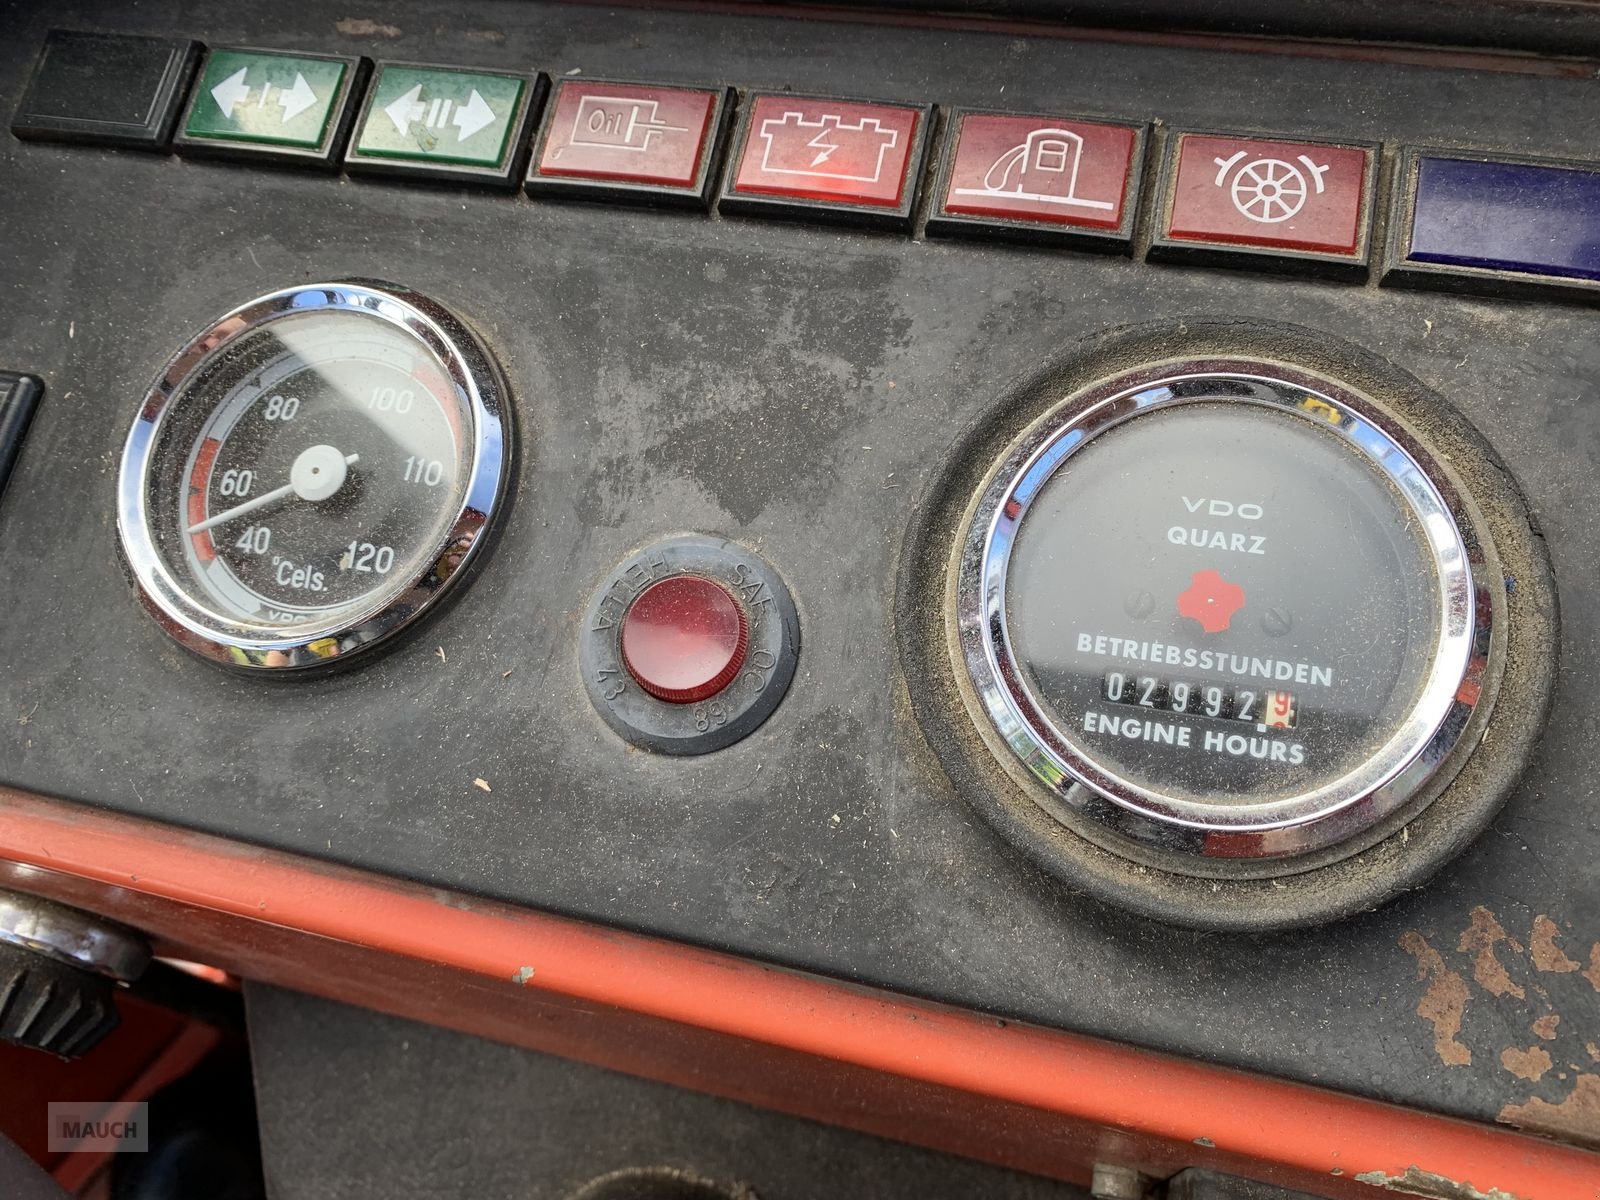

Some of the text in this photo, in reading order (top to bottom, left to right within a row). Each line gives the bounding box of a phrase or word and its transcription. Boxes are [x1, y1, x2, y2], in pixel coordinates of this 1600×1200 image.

[588, 109, 623, 135] Oil
[264, 396, 300, 421] 80
[367, 387, 414, 414] 100
[219, 470, 252, 496] 60
[403, 456, 444, 486] 110
[1182, 496, 1263, 520] VDO
[236, 527, 271, 555] 40
[1167, 526, 1266, 554] QUARZ
[347, 541, 394, 574] 120
[1076, 633, 1332, 687] BETRIEBSSTUNDEN
[1083, 711, 1305, 765] ENGINE HOURS
